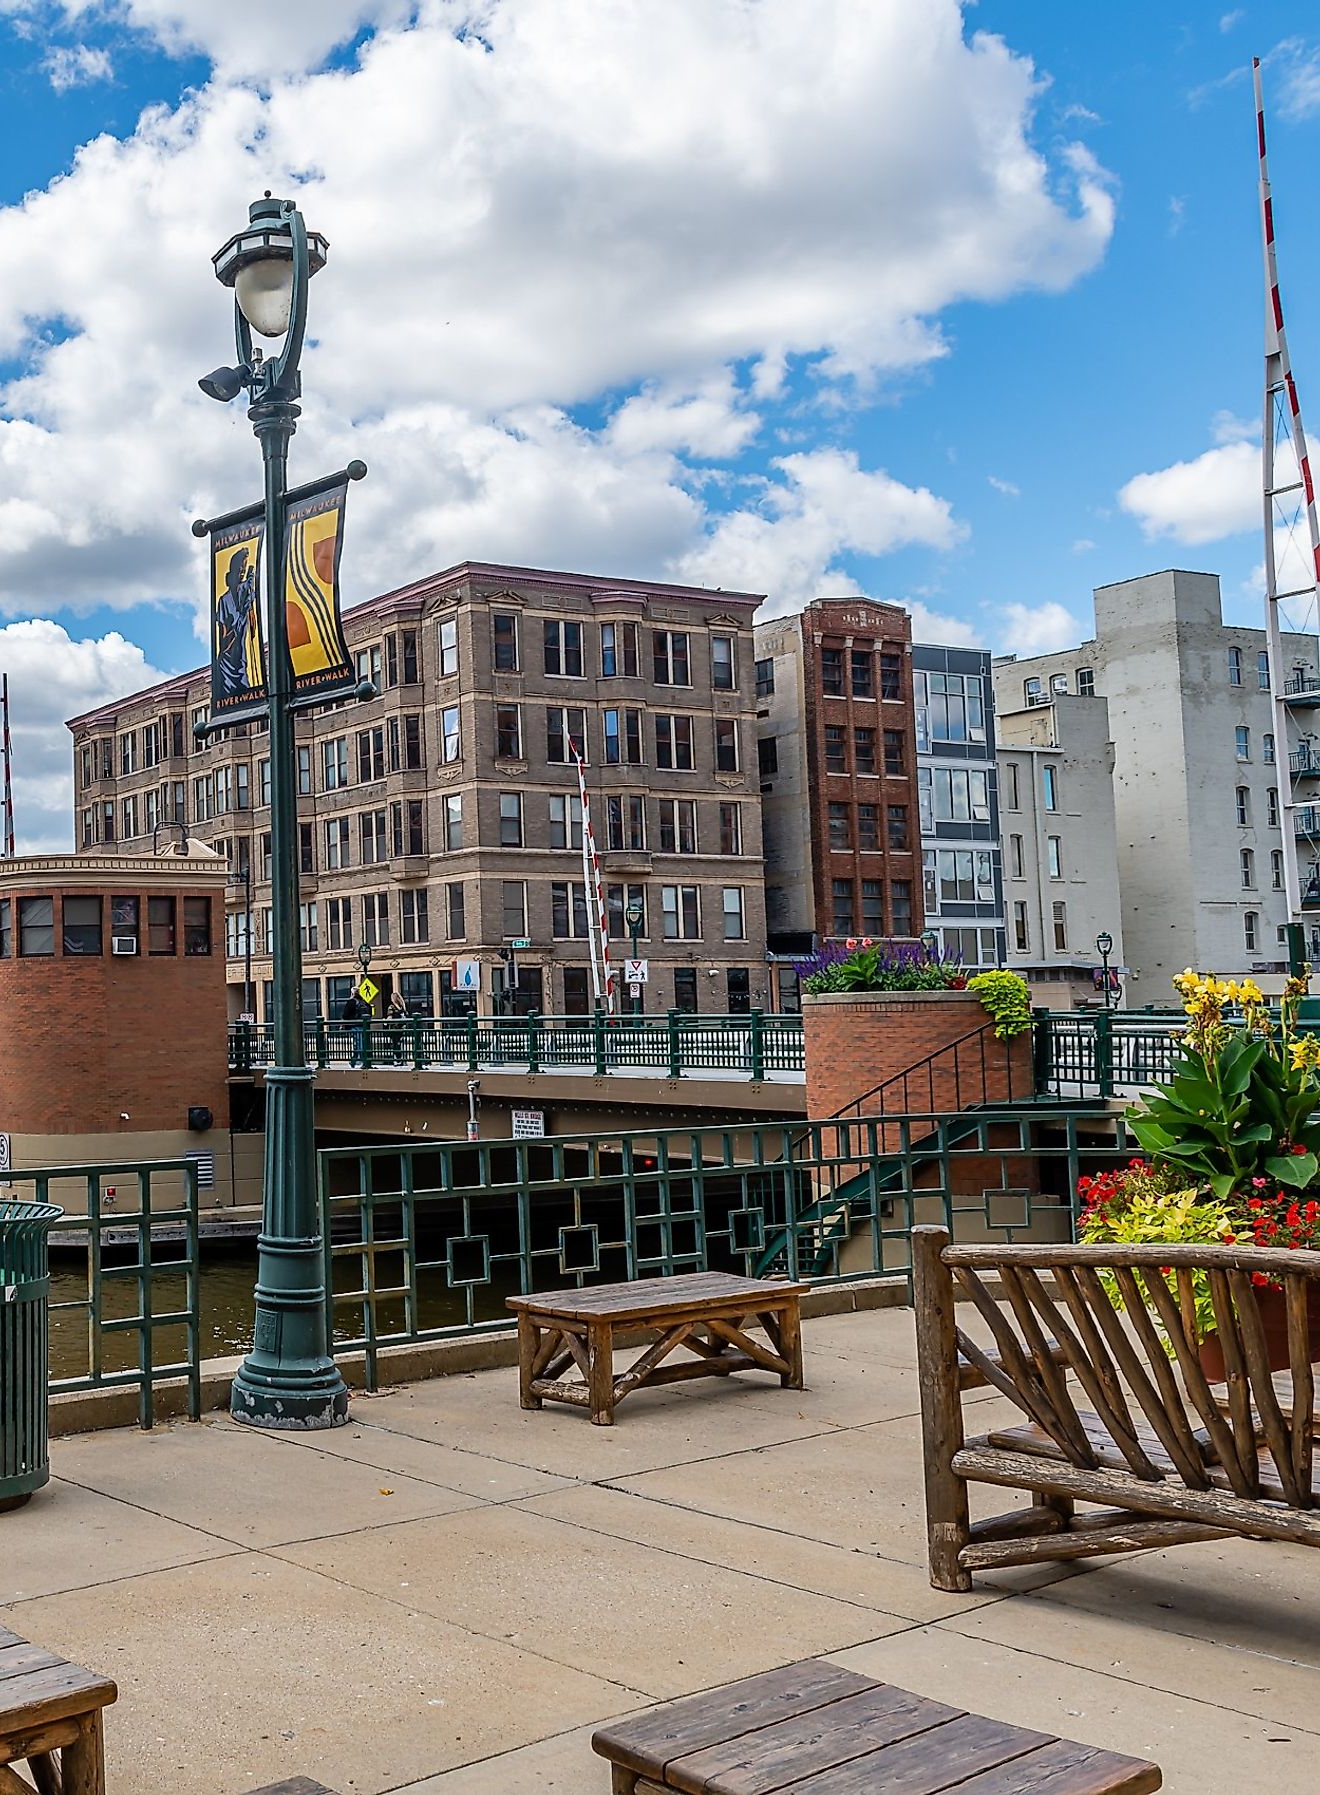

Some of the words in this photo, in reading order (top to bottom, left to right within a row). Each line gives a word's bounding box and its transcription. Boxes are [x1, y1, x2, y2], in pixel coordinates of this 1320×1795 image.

[290, 495, 342, 520] MILWAUKEE
[215, 525, 261, 548] MILWAUKEE
[0, 1138, 6, 1156] 5
